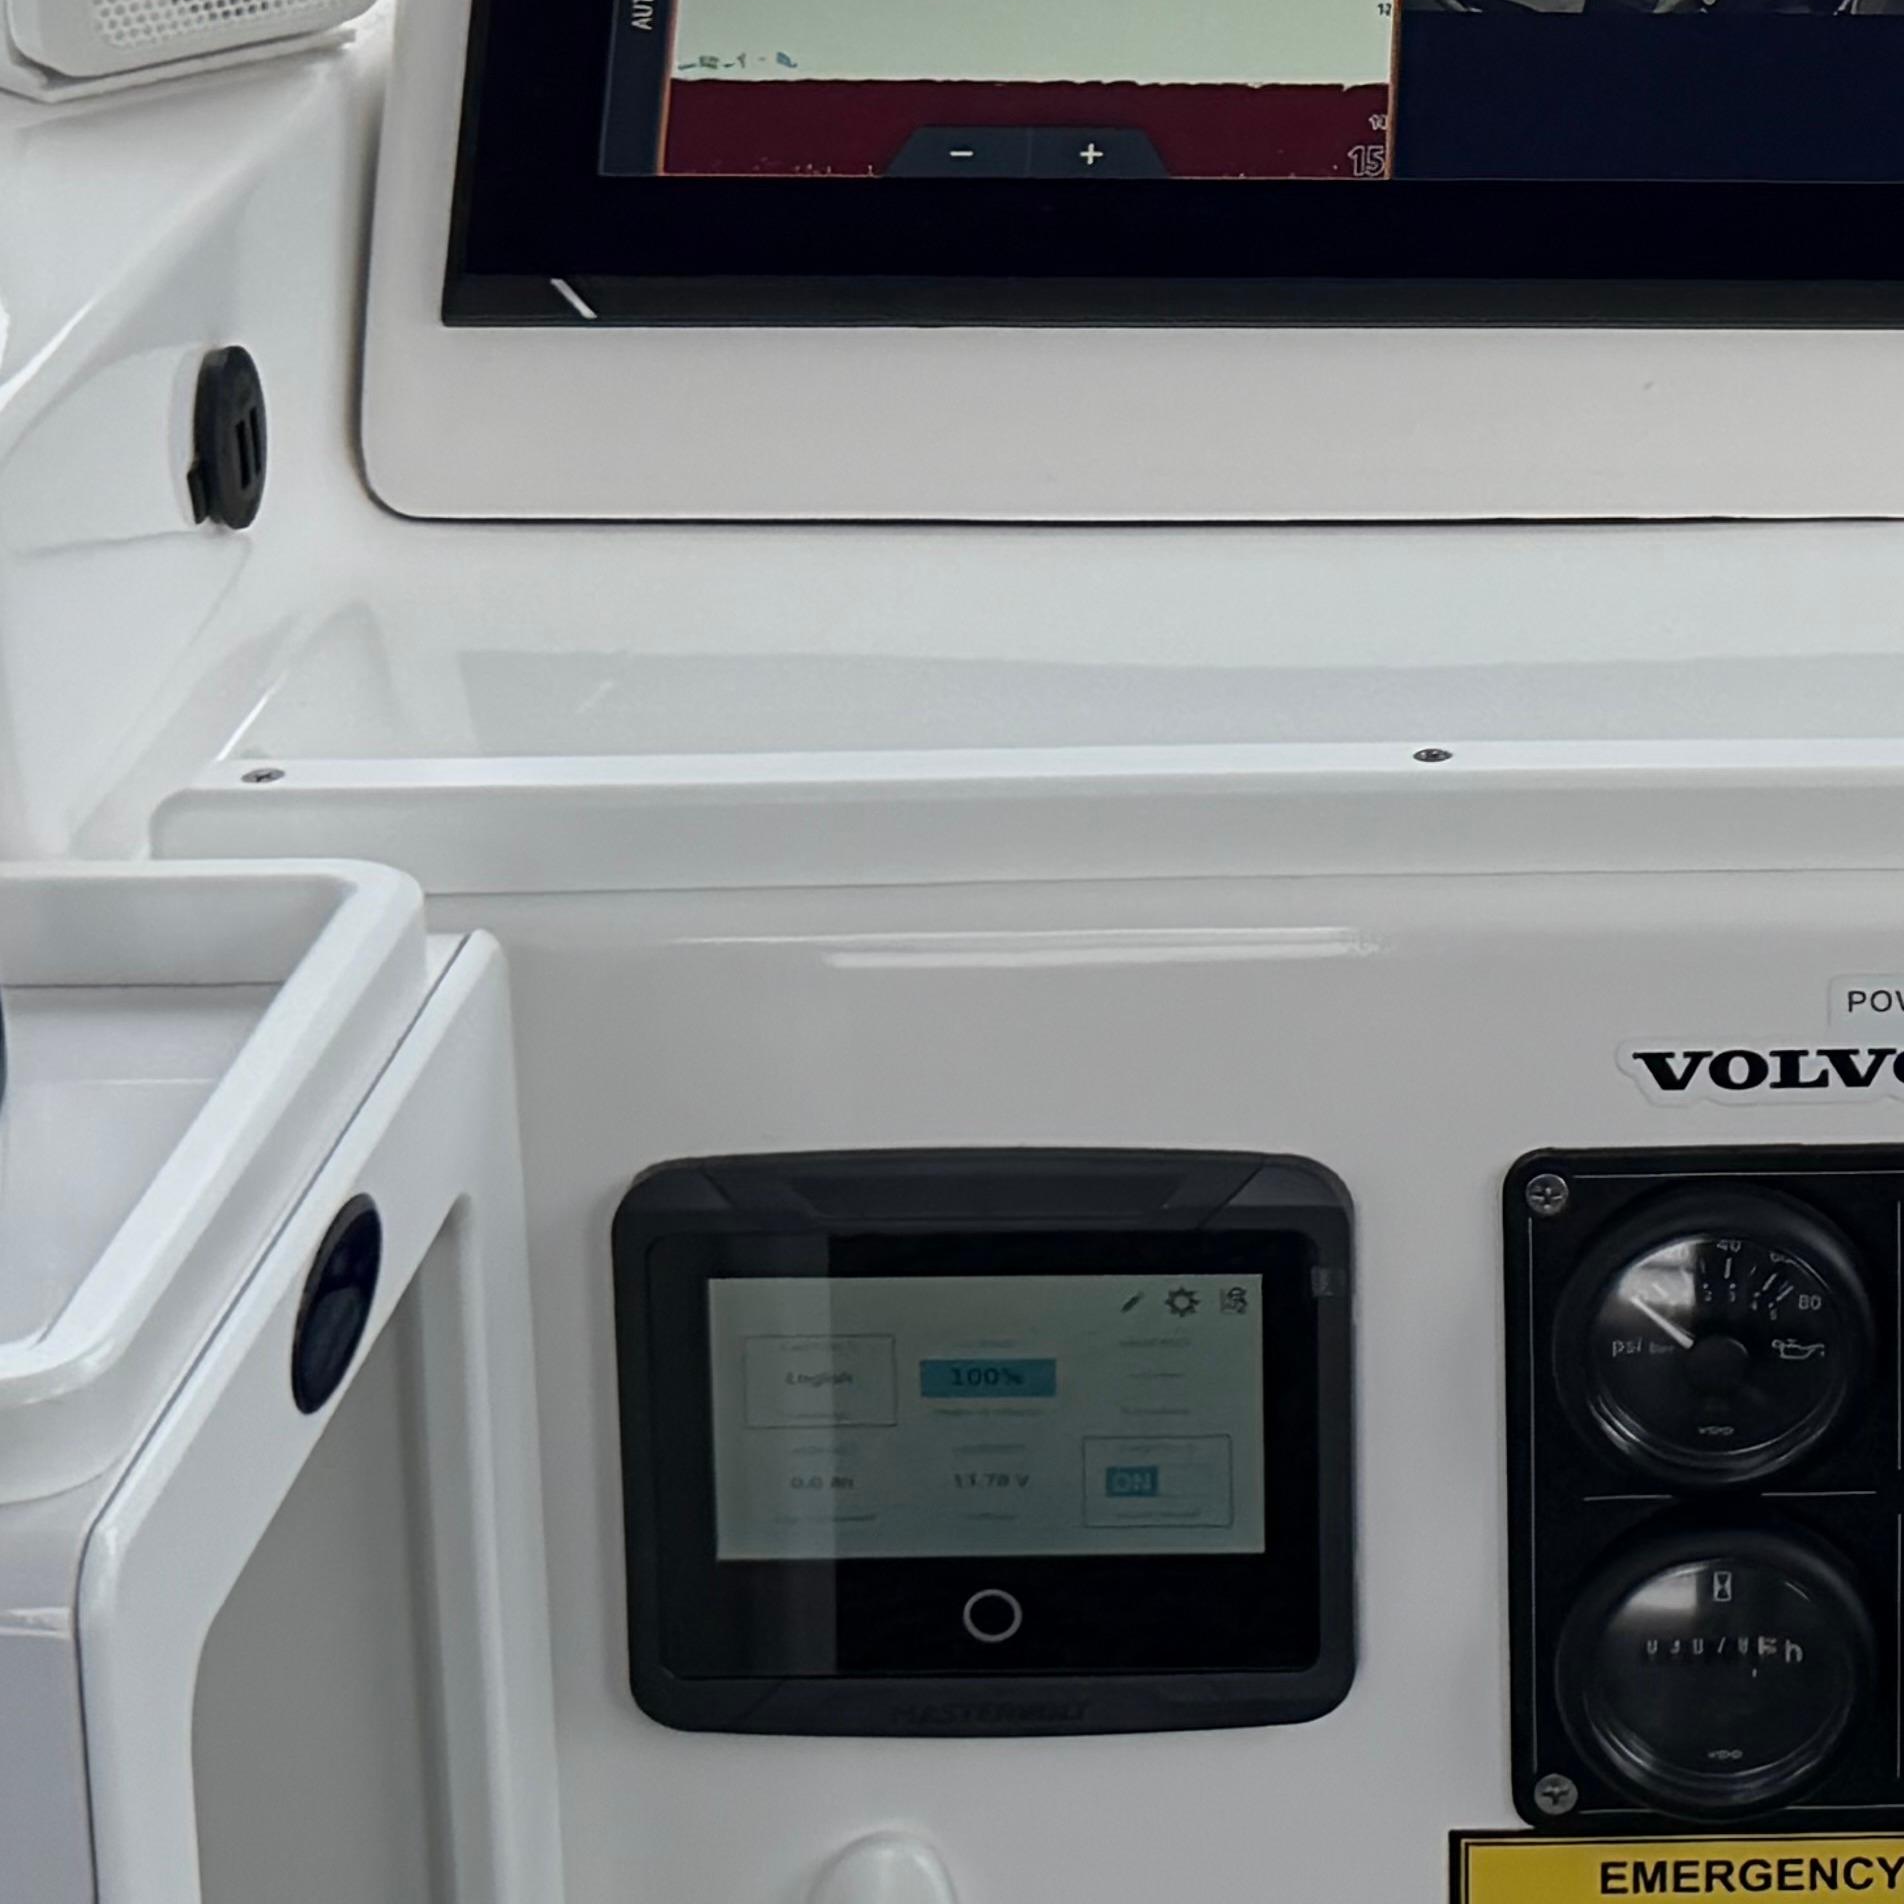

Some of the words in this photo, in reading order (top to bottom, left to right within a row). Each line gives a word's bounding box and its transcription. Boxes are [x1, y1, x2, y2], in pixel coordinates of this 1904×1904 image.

[1347, 143, 1386, 179] 15
[1797, 1294, 1823, 1311] 80
[1611, 1337, 1644, 1359] psi
